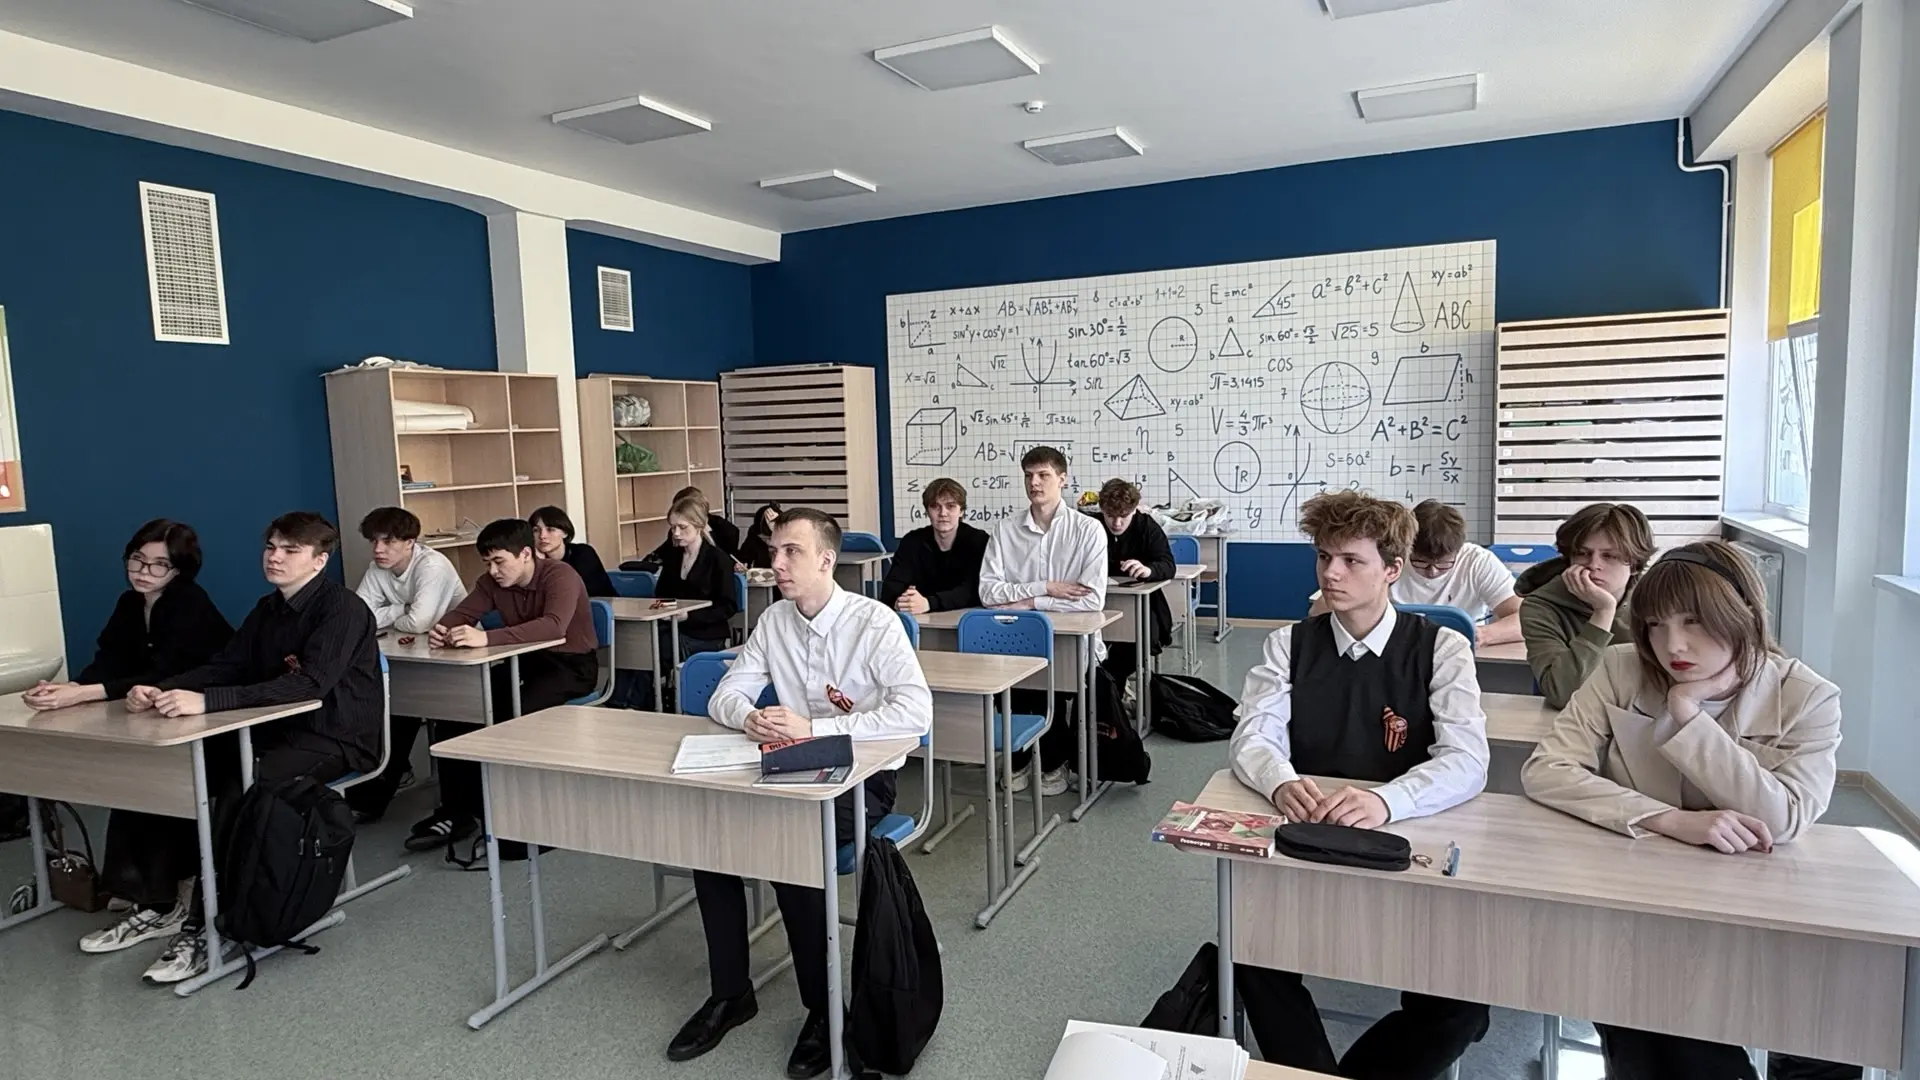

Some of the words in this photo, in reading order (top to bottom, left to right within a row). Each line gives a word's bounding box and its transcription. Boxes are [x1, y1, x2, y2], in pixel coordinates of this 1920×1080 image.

[1194, 303, 1204, 316] 3
[1434, 299, 1472, 331] ABC
[1464, 368, 1474, 384] h
[1175, 423, 1184, 437] 5
[1240, 471, 1248, 483] R
